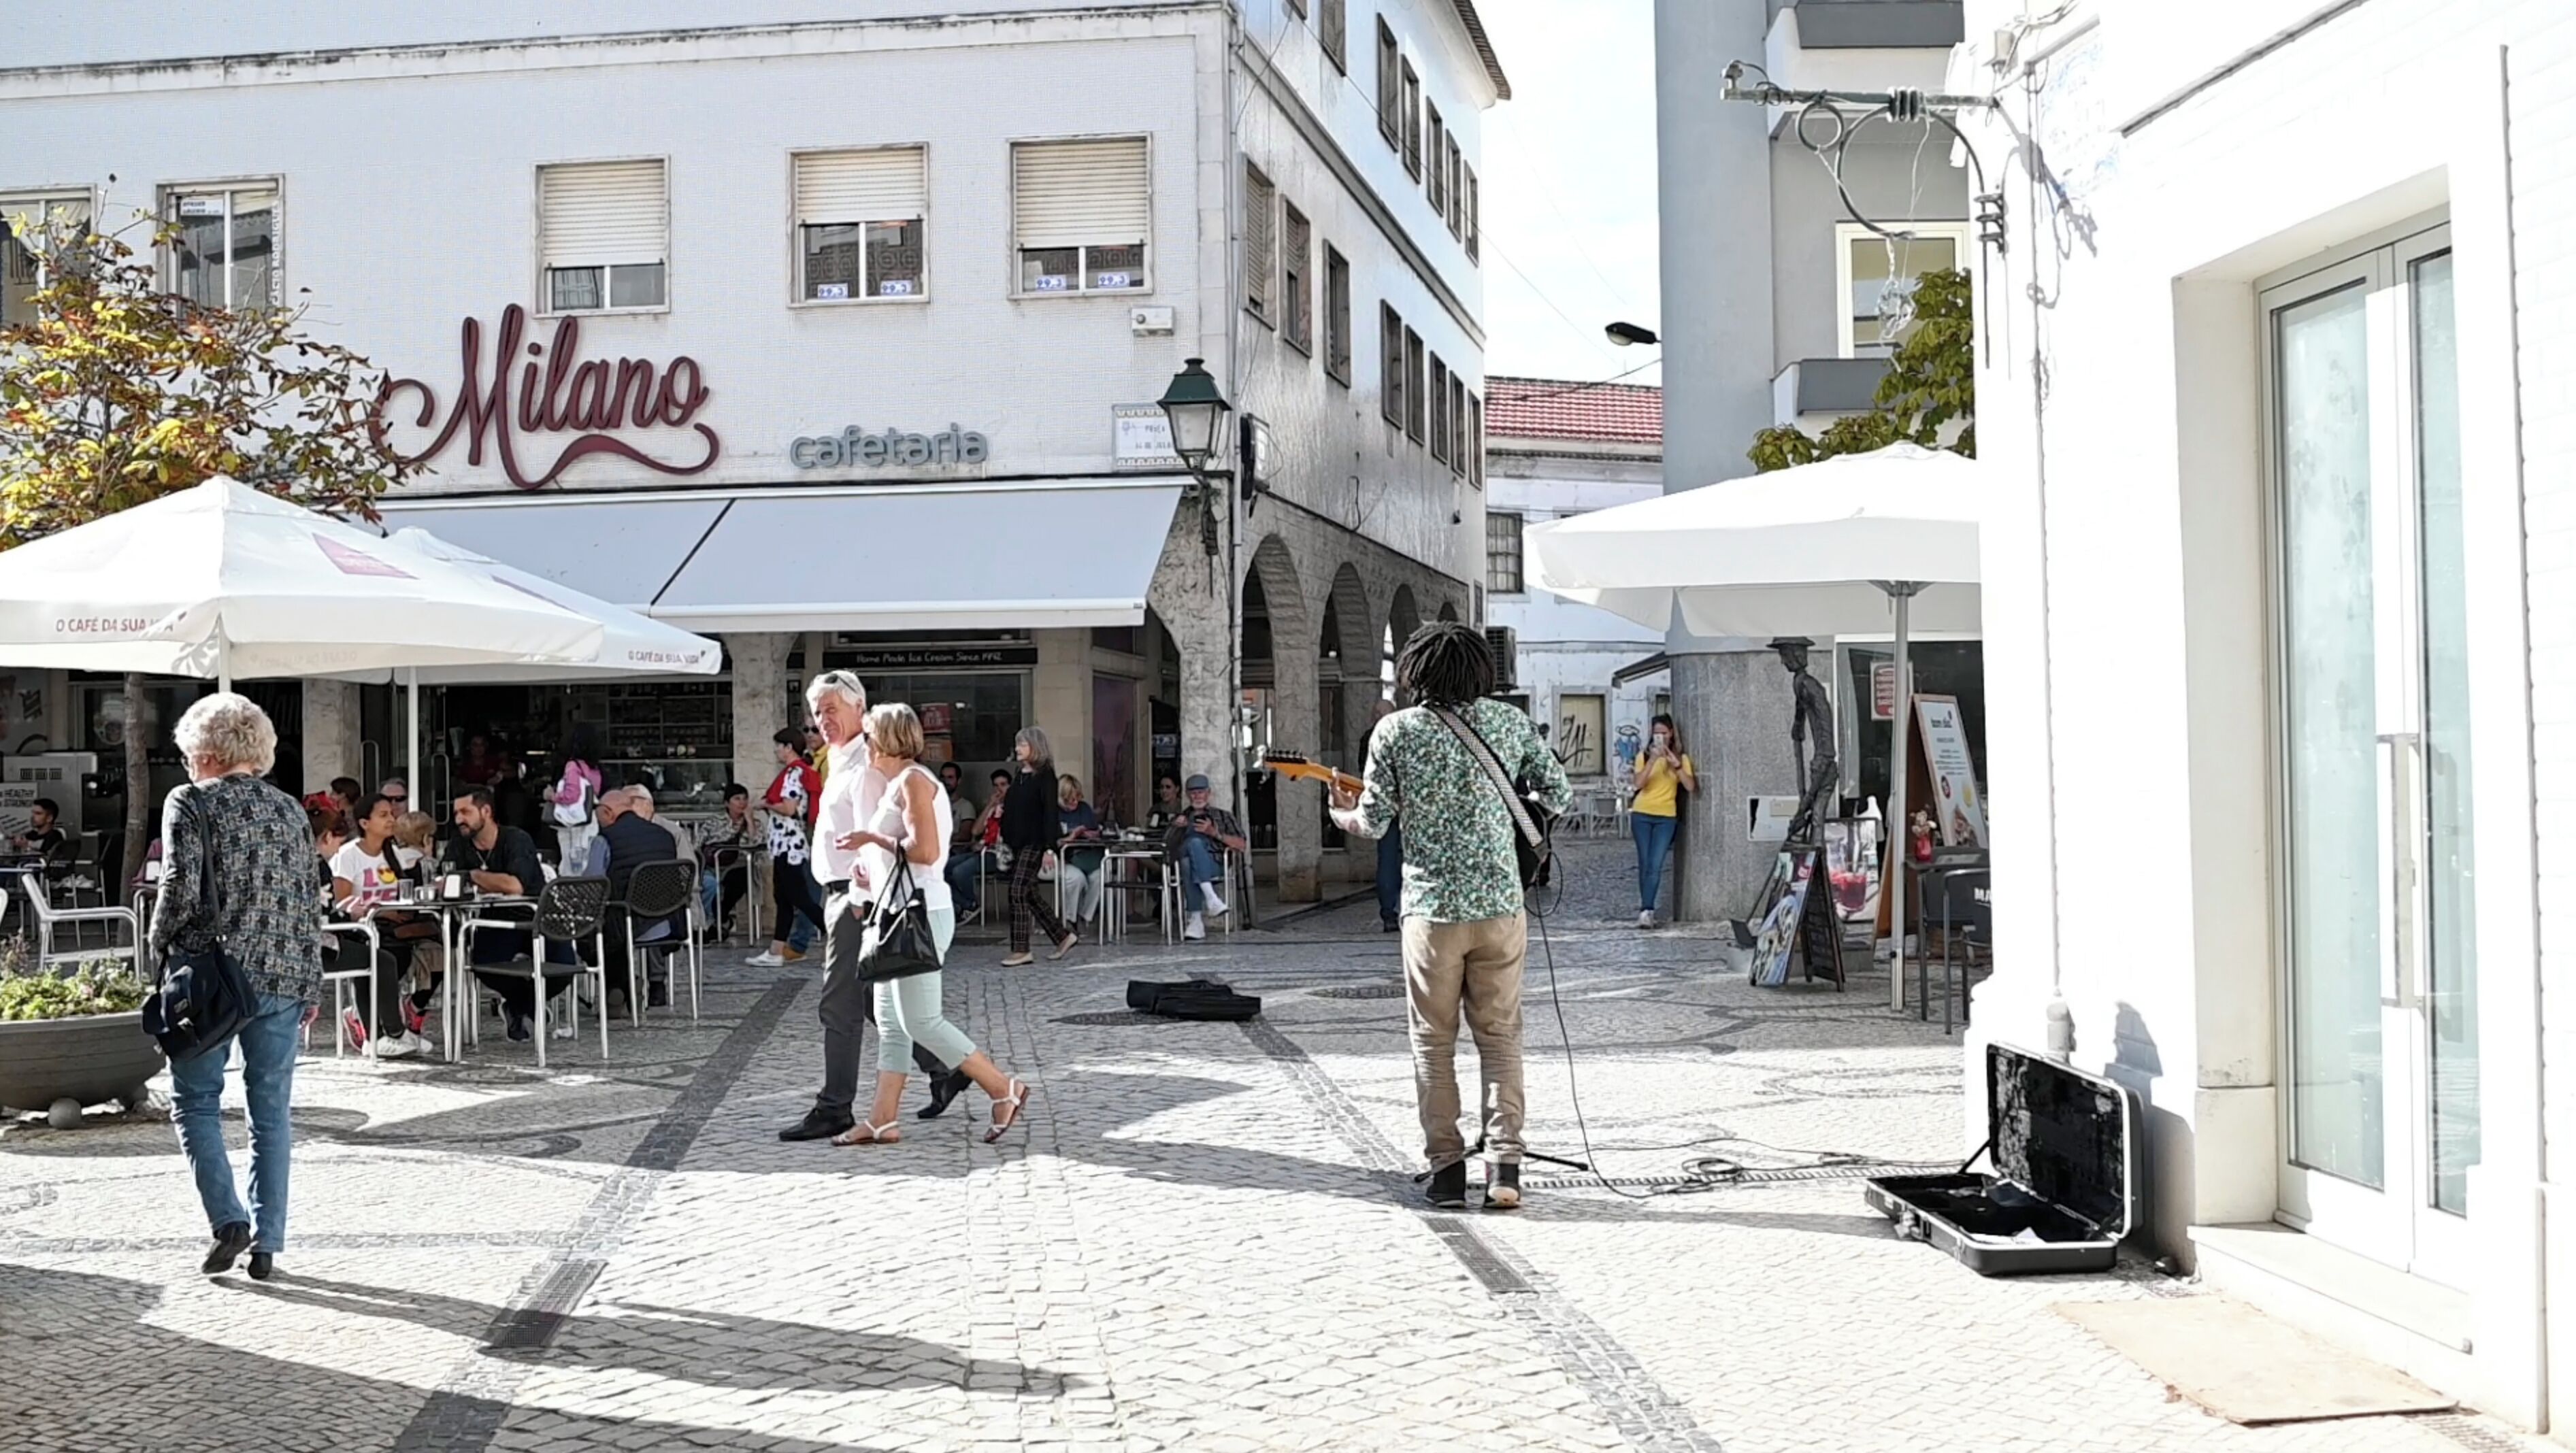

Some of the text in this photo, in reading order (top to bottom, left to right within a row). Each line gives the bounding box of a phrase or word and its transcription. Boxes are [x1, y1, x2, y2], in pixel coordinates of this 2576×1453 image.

[369, 303, 719, 490] Milano
[790, 422, 988, 469] cafetaria
[56, 619, 65, 632] O
[69, 616, 99, 632] CAFÉ
[102, 618, 118, 632] DA
[121, 618, 146, 632] SUA
